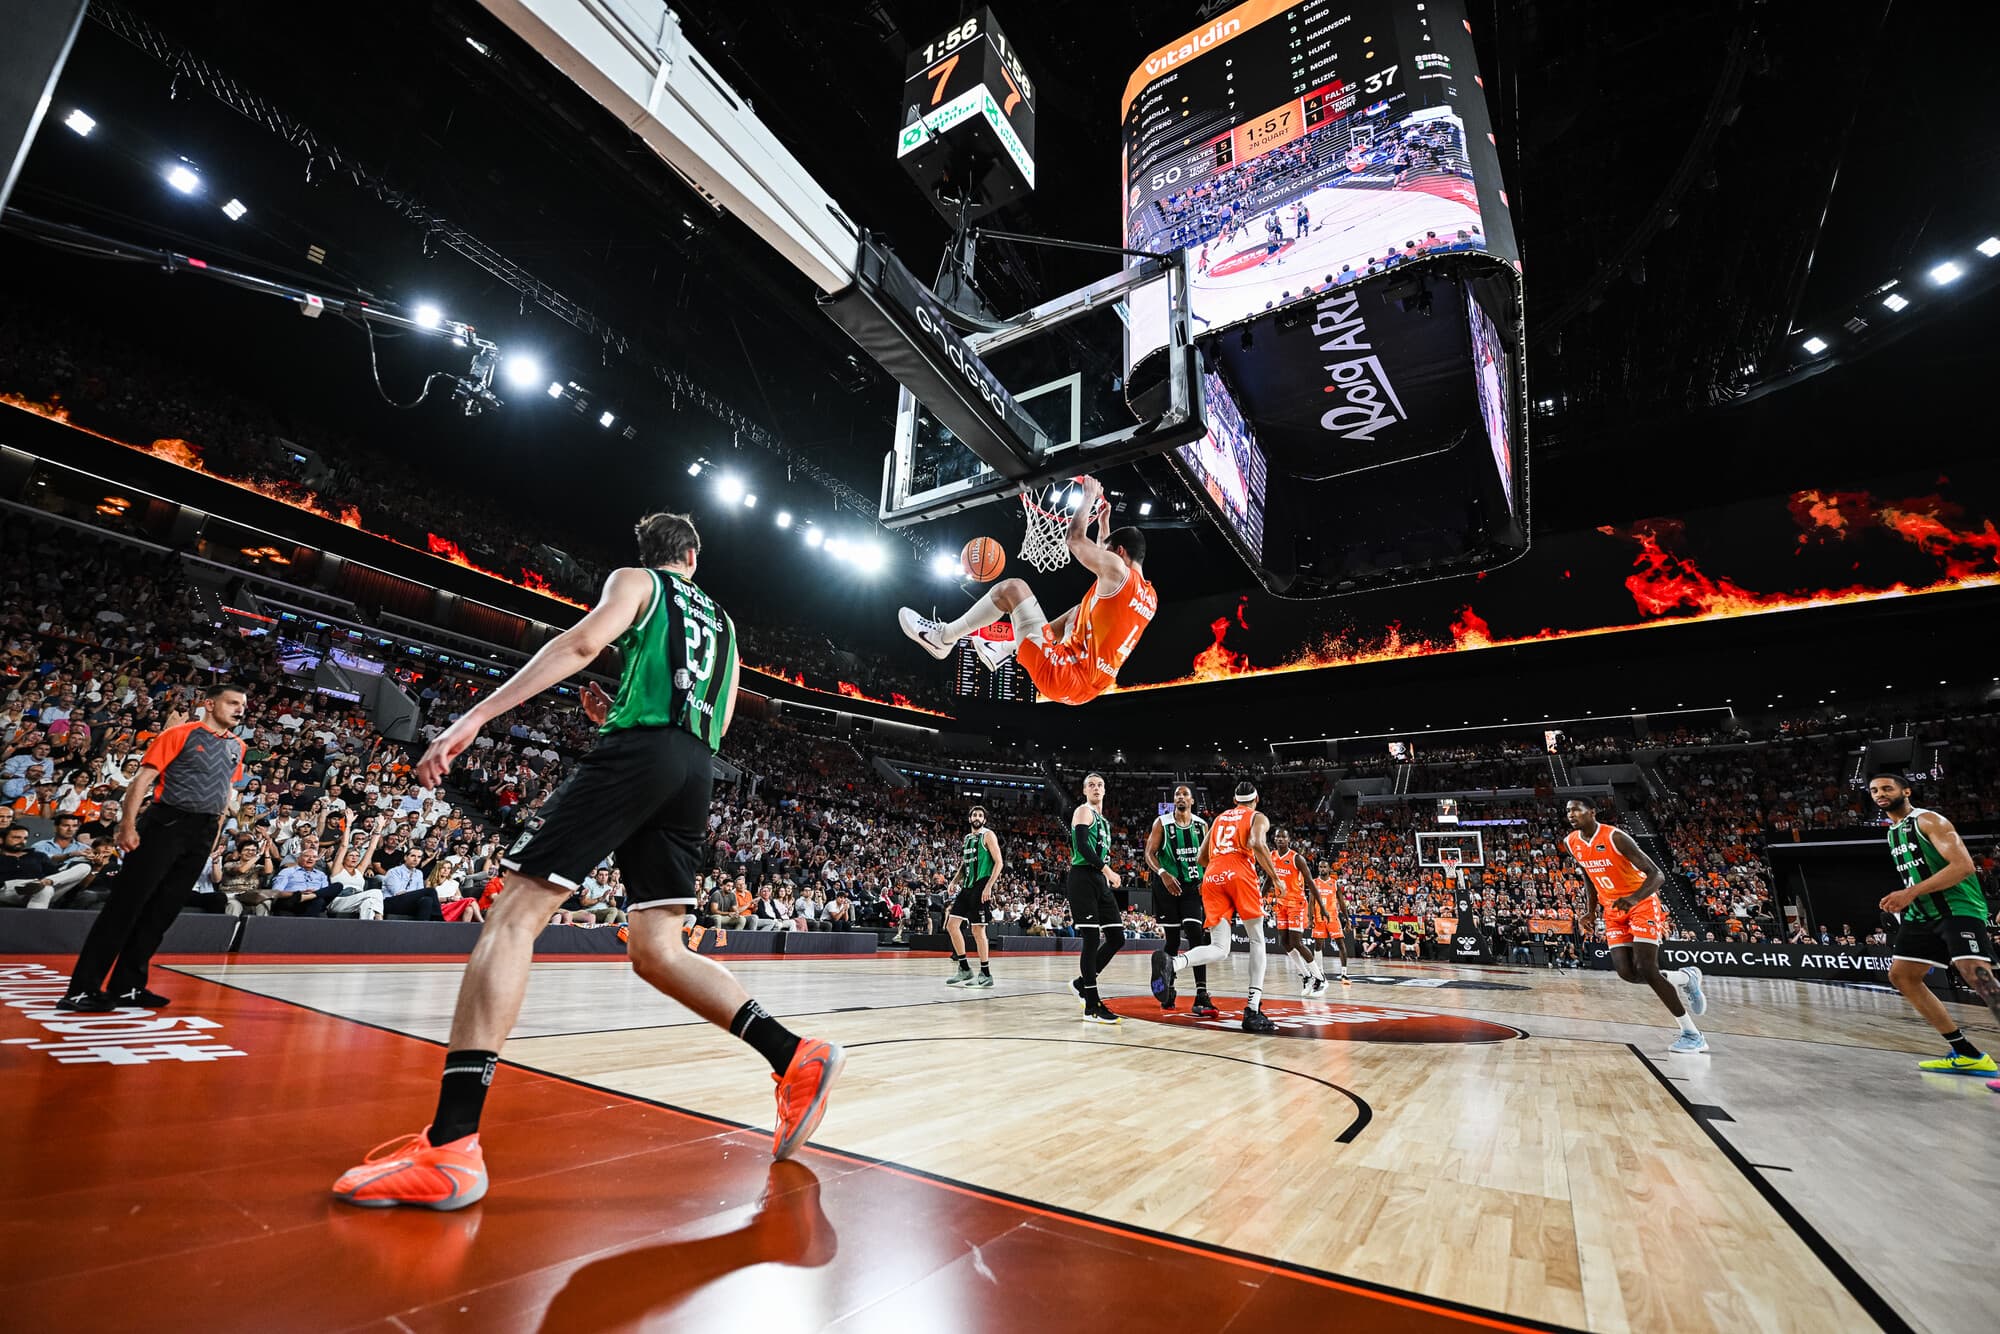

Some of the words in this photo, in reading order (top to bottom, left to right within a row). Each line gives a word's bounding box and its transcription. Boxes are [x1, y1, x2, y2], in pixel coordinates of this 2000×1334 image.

[1290, 26, 1297, 34] 9
[1304, 9, 1330, 25] RUBIO
[1306, 15, 1351, 42] HAKANSON
[923, 18, 977, 64] 1:56
[1145, 18, 1240, 76] Vitaldin
[1290, 54, 1303, 64] 24
[1308, 40, 1332, 56] HUNT
[998, 33, 1031, 99] 1:56
[1292, 68, 1305, 79] 25
[1310, 53, 1338, 71] MORIN
[928, 55, 959, 105] 7
[1001, 66, 1021, 117] 7
[1293, 83, 1306, 94] 23
[1311, 70, 1336, 87] RUZIC
[1364, 65, 1398, 94] 37
[1309, 101, 1318, 109] 4
[1325, 82, 1357, 102] FALTES
[1311, 113, 1318, 121] 1
[1331, 95, 1357, 110] TEMPS
[1334, 100, 1357, 114] MORT
[1247, 111, 1291, 141] 1:57
[1261, 128, 1289, 145] QUART
[1220, 141, 1228, 150] 5
[1221, 154, 1228, 163] 1
[1151, 166, 1181, 191] 50
[1258, 186, 1291, 205] TOYOTA
[916, 306, 1006, 420] endesa
[1320, 354, 1408, 441] Roig
[684, 616, 716, 681] 23
[1442, 805, 1450, 815] 7
[1216, 825, 1236, 848] 12
[1187, 866, 1200, 878] 25
[1595, 876, 1615, 889] 10
[1664, 949, 1738, 966] TOYOTA
[1741, 952, 1791, 967] C-HR
